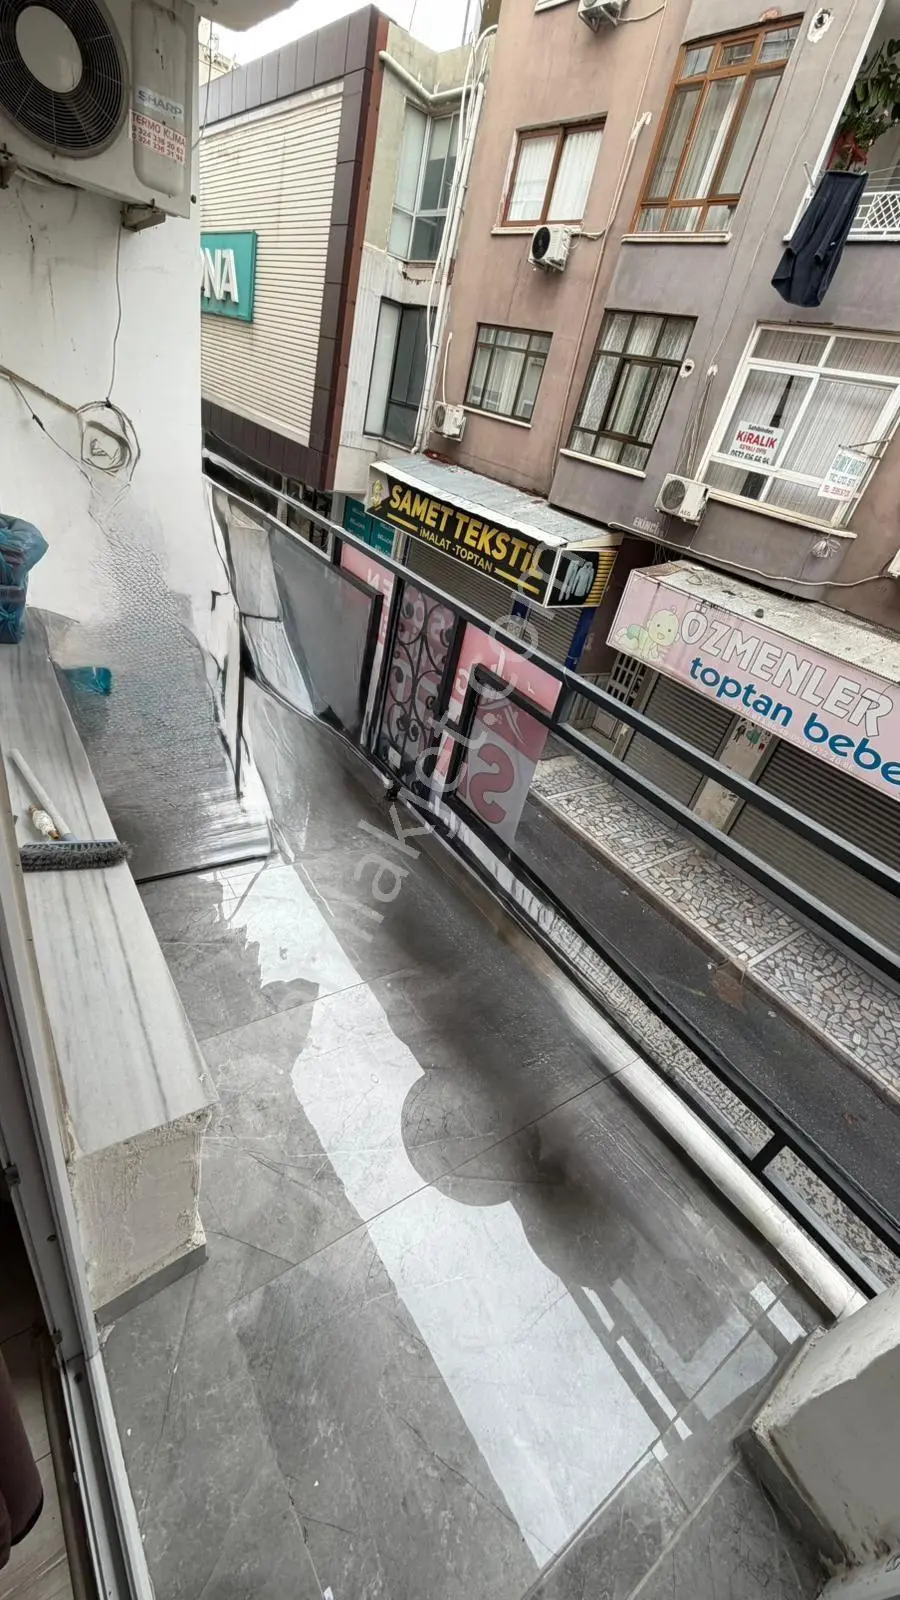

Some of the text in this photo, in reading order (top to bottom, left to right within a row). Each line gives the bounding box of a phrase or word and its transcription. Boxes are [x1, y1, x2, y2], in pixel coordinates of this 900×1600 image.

[138, 90, 182, 114] SHARP
[389, 484, 454, 532] SAMET
[681, 603, 894, 737] ÖZMENLER
[690, 657, 793, 727] toptan
[803, 712, 900, 785] bebe
